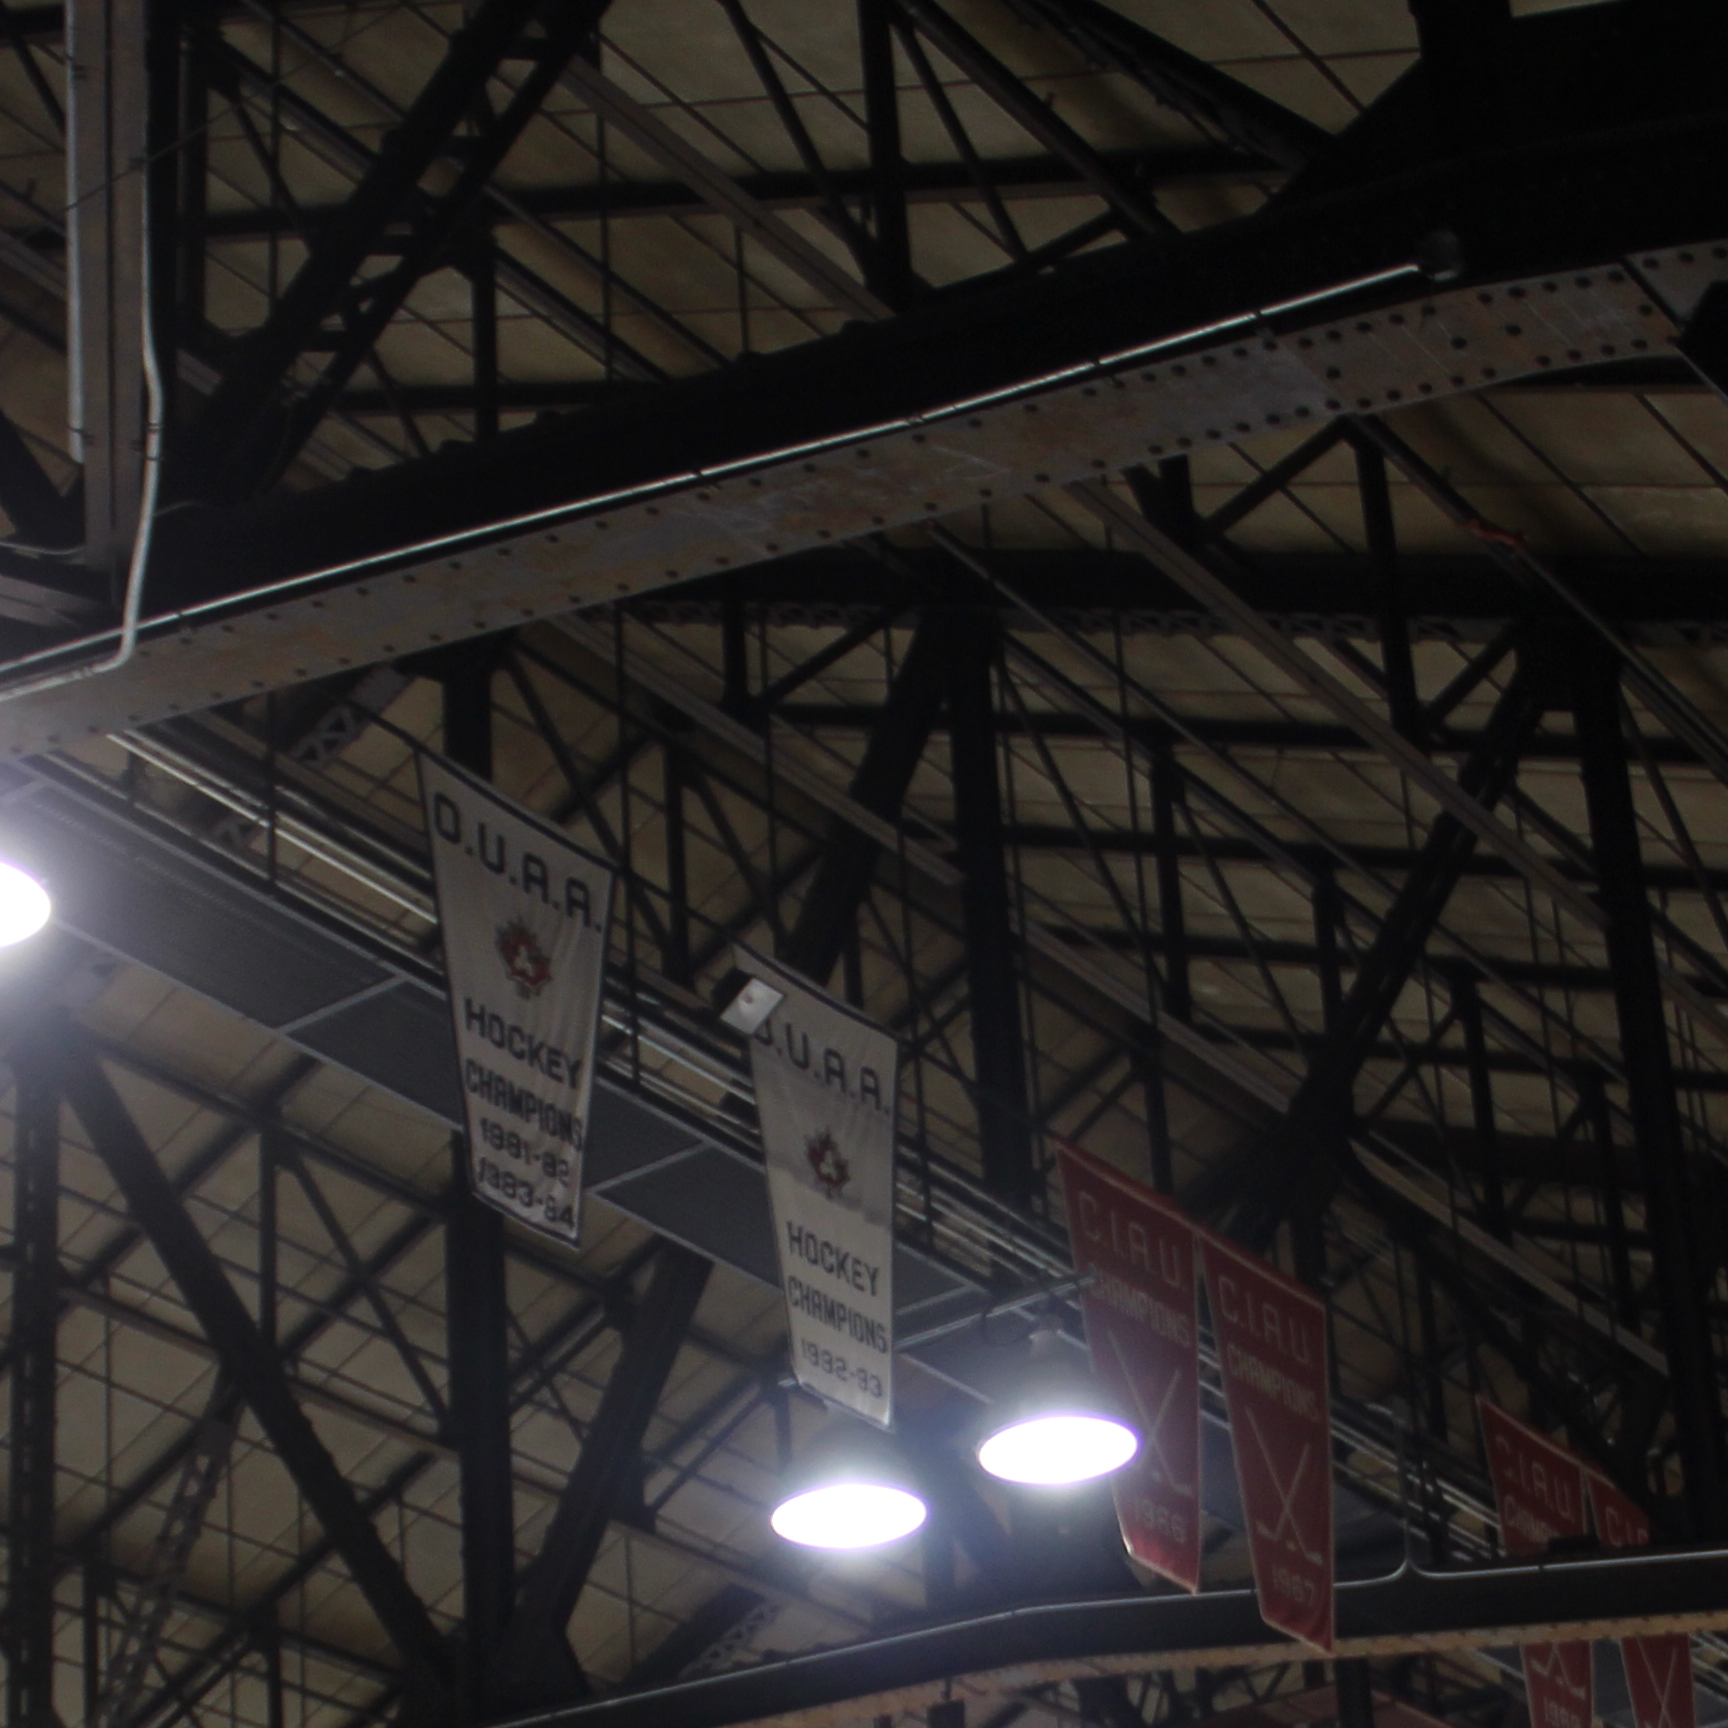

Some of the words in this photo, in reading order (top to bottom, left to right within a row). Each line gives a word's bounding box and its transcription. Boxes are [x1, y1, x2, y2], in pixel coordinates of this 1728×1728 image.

[465, 997, 580, 1089] HOCKEY
[465, 1058, 584, 1152] CHAMPIONS
[787, 1220, 879, 1298] HOCKEY
[786, 1274, 889, 1354] CHAMPIONS
